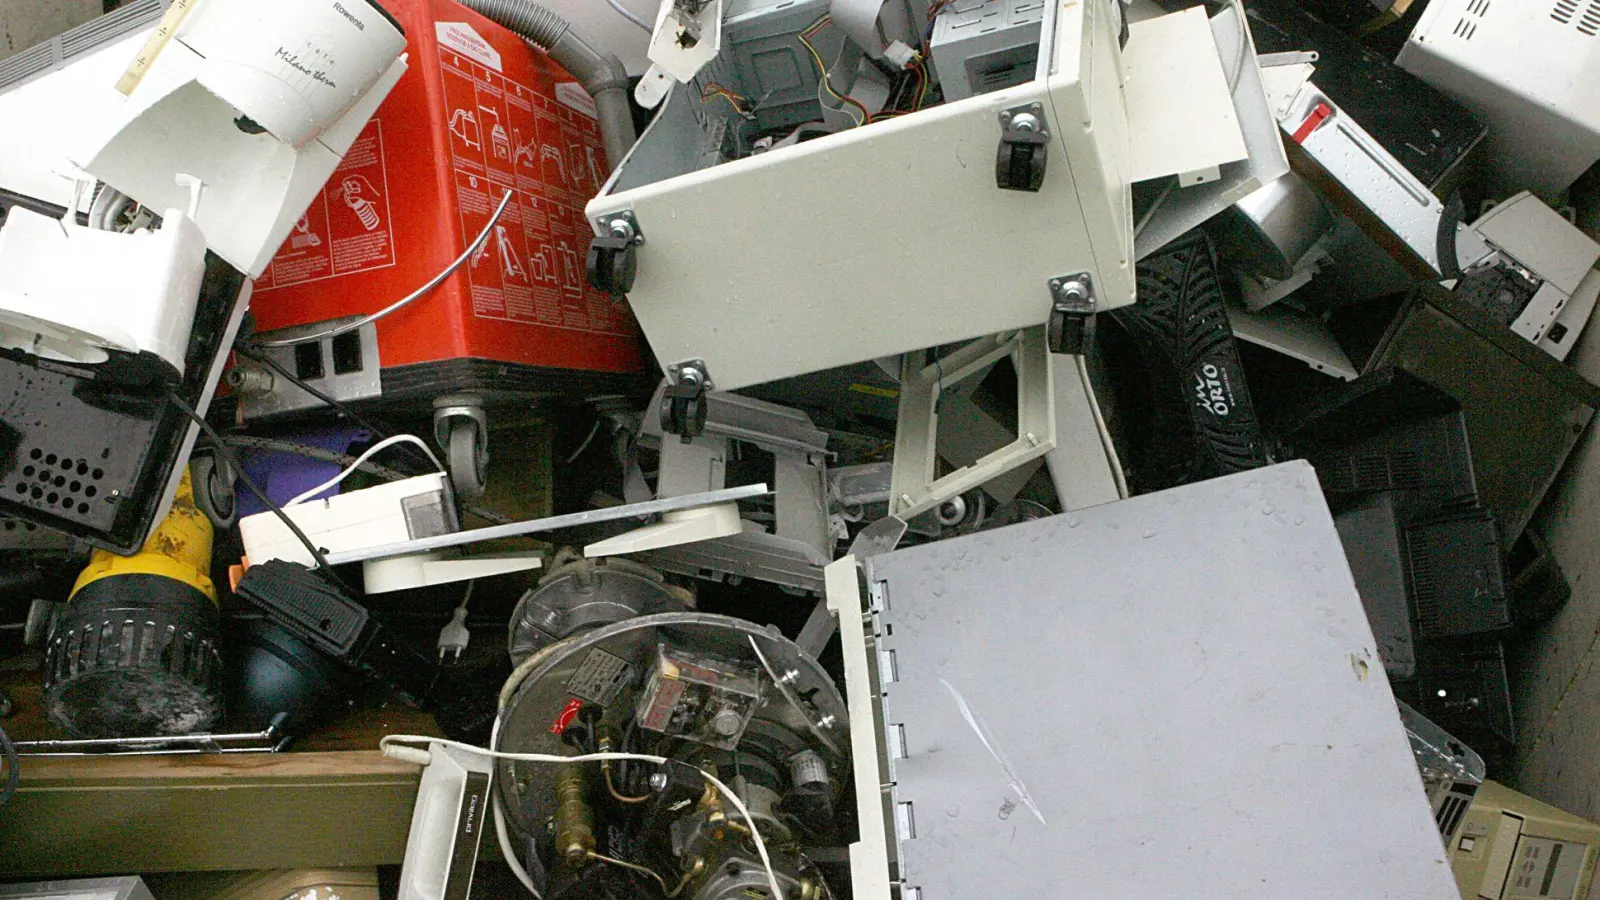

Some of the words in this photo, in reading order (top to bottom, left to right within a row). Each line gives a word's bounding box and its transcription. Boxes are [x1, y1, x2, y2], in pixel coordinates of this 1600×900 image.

[333, 2, 365, 31] Rowenta
[275, 46, 312, 76] Milano
[313, 70, 337, 88] therm
[453, 56, 459, 67] 4
[485, 71, 492, 82] 5
[517, 86, 522, 96] 6
[468, 176, 478, 188] 10
[1203, 363, 1229, 416] ORTO
